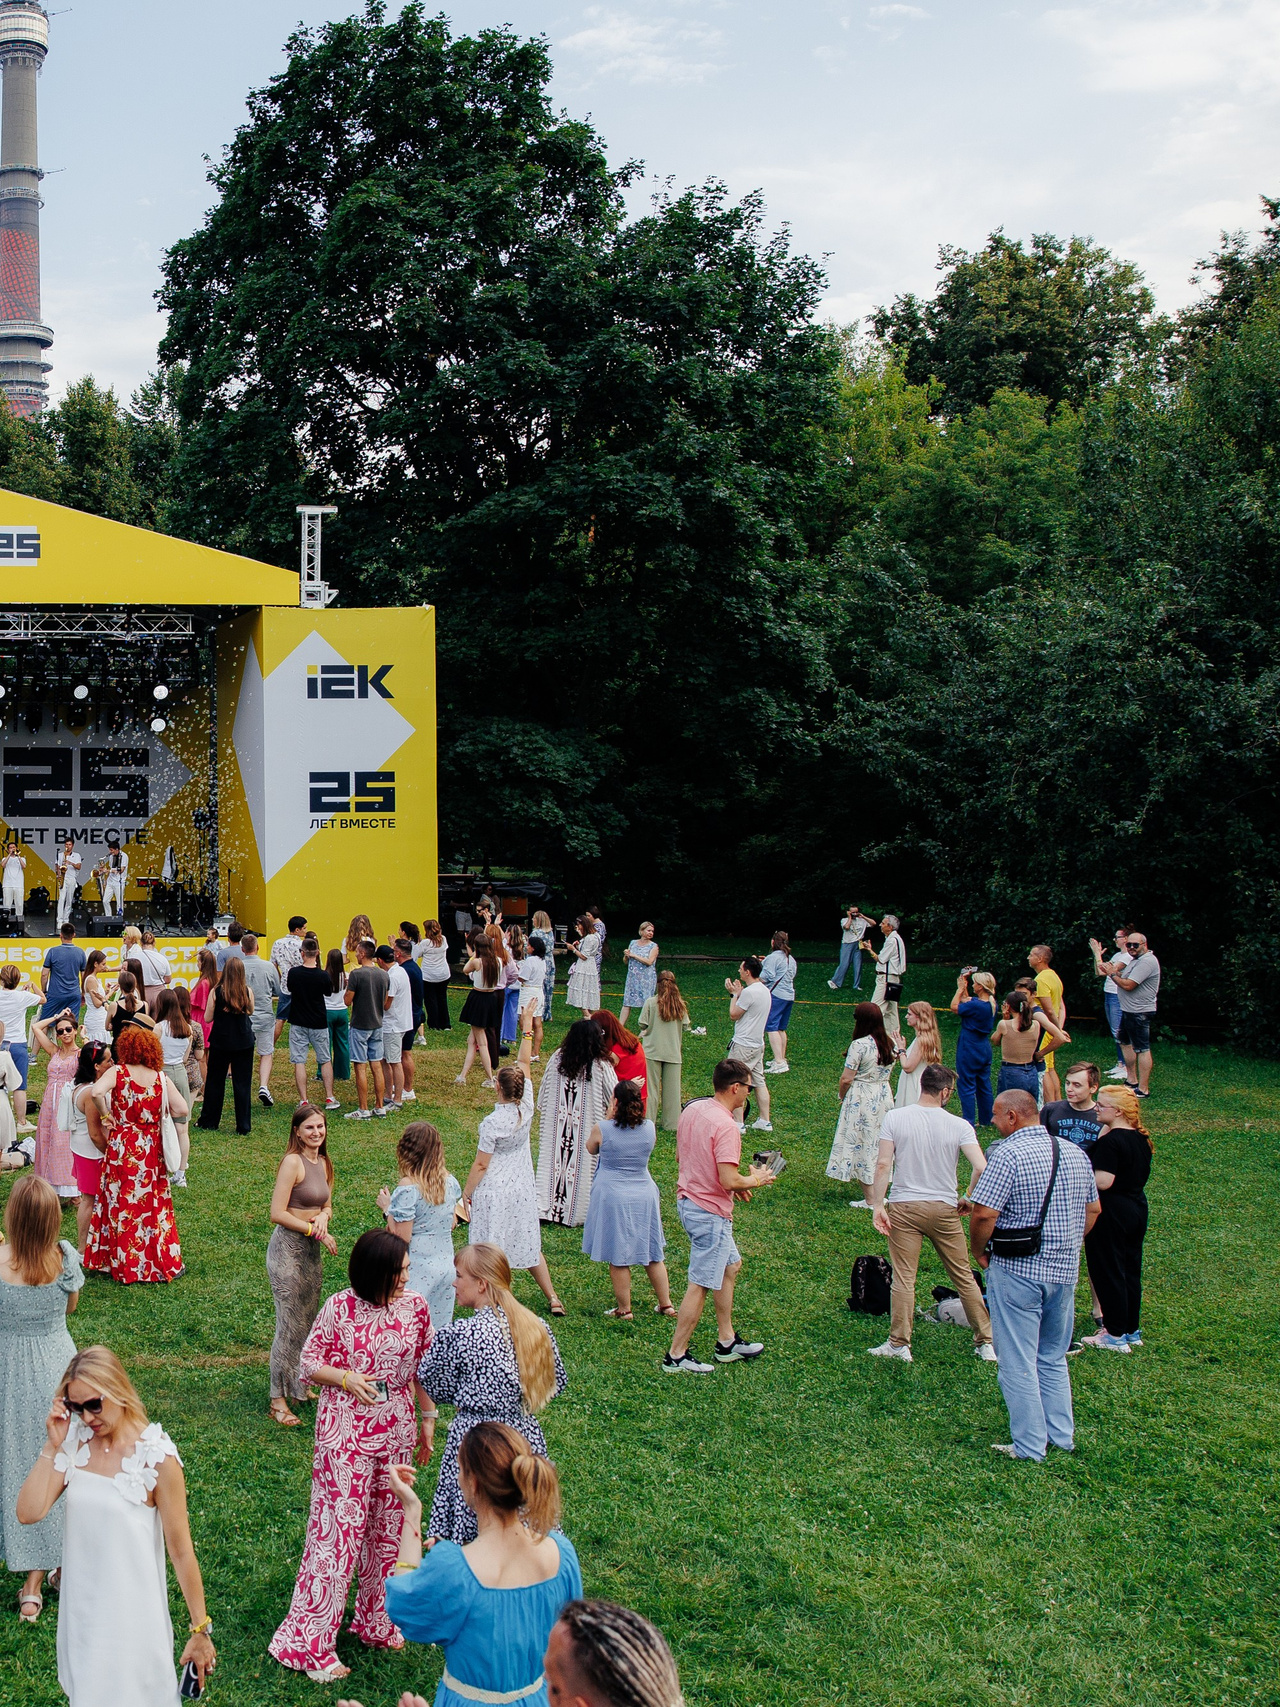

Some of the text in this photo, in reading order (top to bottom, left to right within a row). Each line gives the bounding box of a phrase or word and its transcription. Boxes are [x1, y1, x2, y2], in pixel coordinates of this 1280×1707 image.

[2, 746, 150, 818] 25
[308, 770, 396, 814] 25
[309, 818, 396, 829] ЛЕТ ВМЕСТЕ
[2, 827, 150, 845] ЛЕТ ВМЕСТЕ
[1057, 1118, 1074, 1127] TOM
